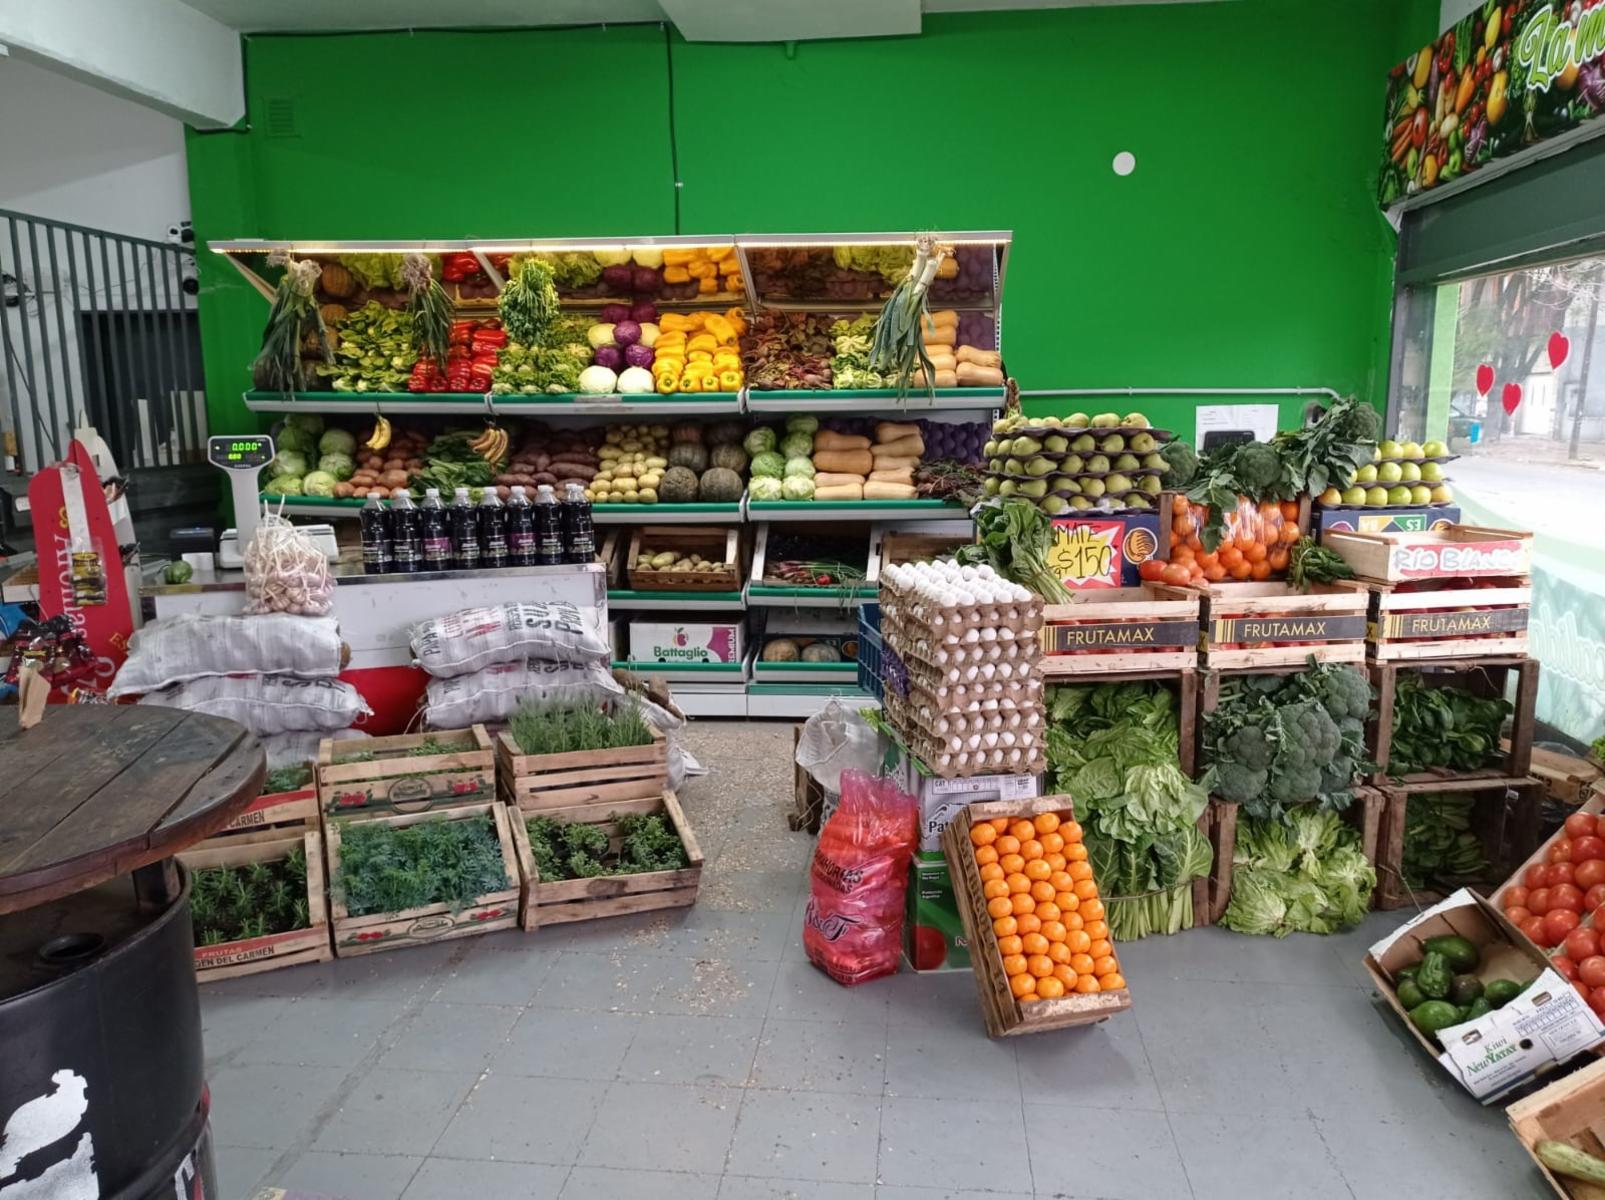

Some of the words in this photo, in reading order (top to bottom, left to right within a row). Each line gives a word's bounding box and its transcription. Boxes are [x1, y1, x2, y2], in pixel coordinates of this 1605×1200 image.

[1519, 4, 1572, 93] La
[1572, 0, 1605, 68] m
[1057, 545, 1113, 579] $150
[1243, 621, 1327, 638] FRUTAMAX
[1411, 615, 1492, 633] FRUTAMAX
[1067, 627, 1155, 646] FRUTAMAX
[653, 645, 708, 660] Battaglio
[216, 955, 234, 966] DEL
[236, 945, 275, 961] CARMEN
[1484, 1036, 1508, 1054] Kiwi
